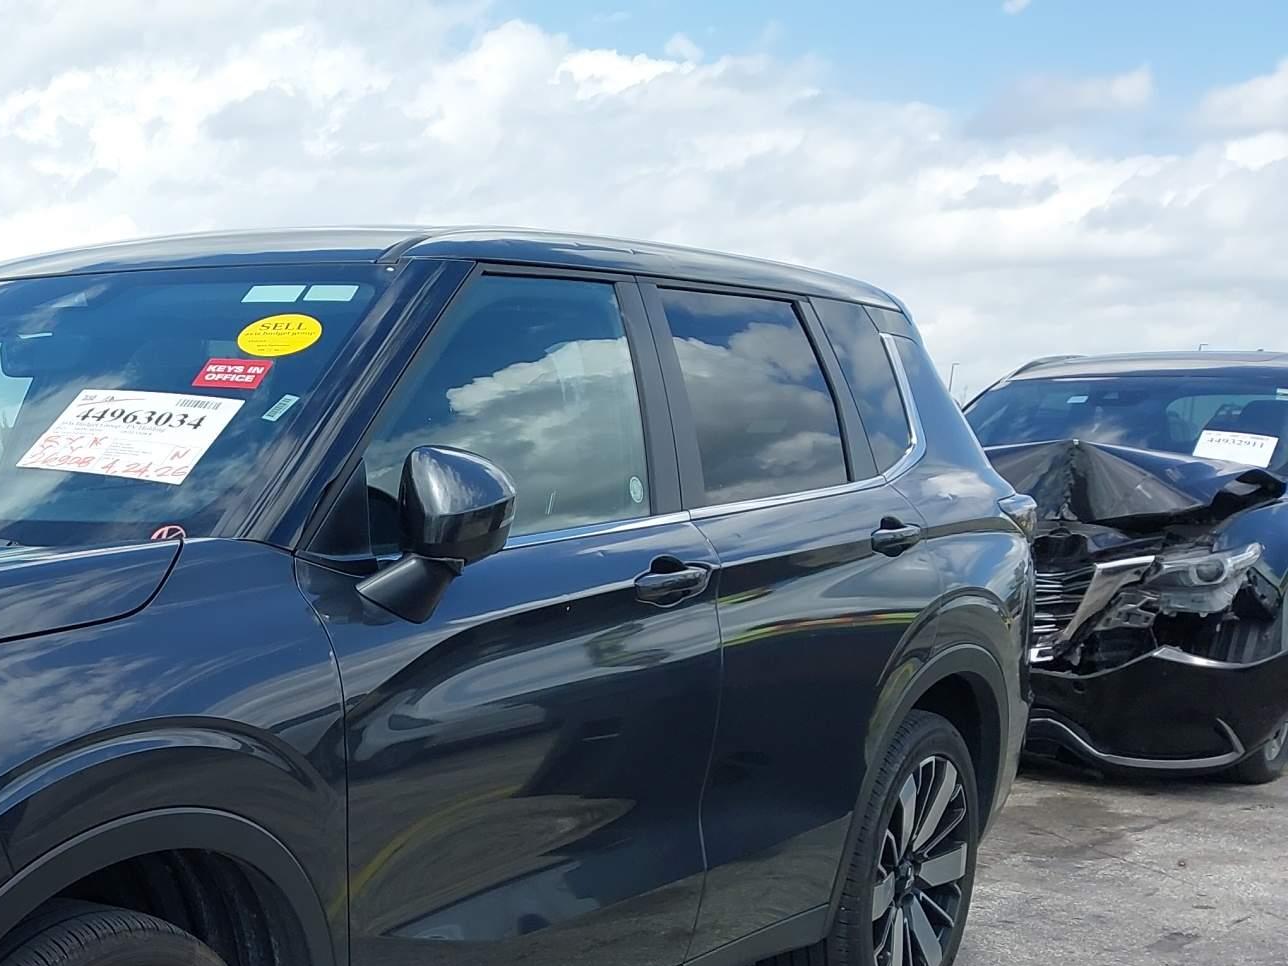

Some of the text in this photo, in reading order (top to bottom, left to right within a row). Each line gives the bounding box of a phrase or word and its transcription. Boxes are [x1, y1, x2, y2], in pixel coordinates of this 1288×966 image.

[259, 322, 307, 330] SELL
[206, 365, 265, 374] KEYS IN
[204, 373, 256, 382] OFFICE
[76, 407, 207, 430] 44963034
